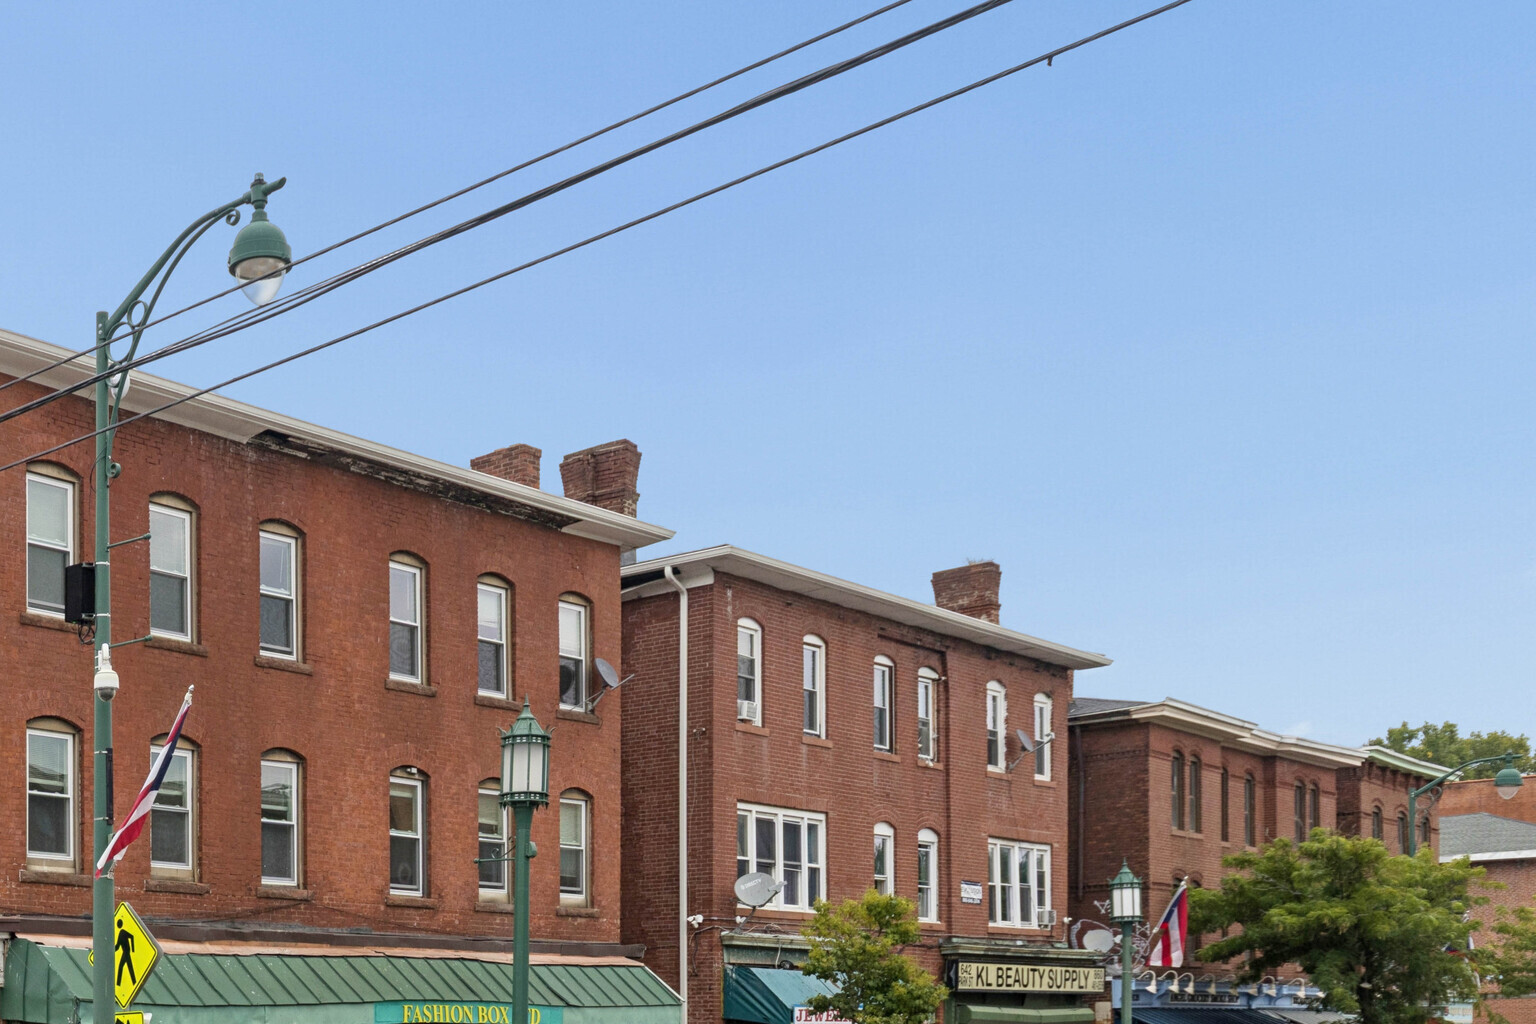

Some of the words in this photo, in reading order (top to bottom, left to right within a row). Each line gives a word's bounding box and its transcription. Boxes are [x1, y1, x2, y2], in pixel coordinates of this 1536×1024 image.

[960, 963, 972, 976] 642
[976, 965, 992, 987] KL
[996, 966, 1046, 988] BEAUTY
[1047, 968, 1091, 989] SUPPLY
[402, 1004, 474, 1024] FASHION
[477, 1005, 510, 1024] BOX
